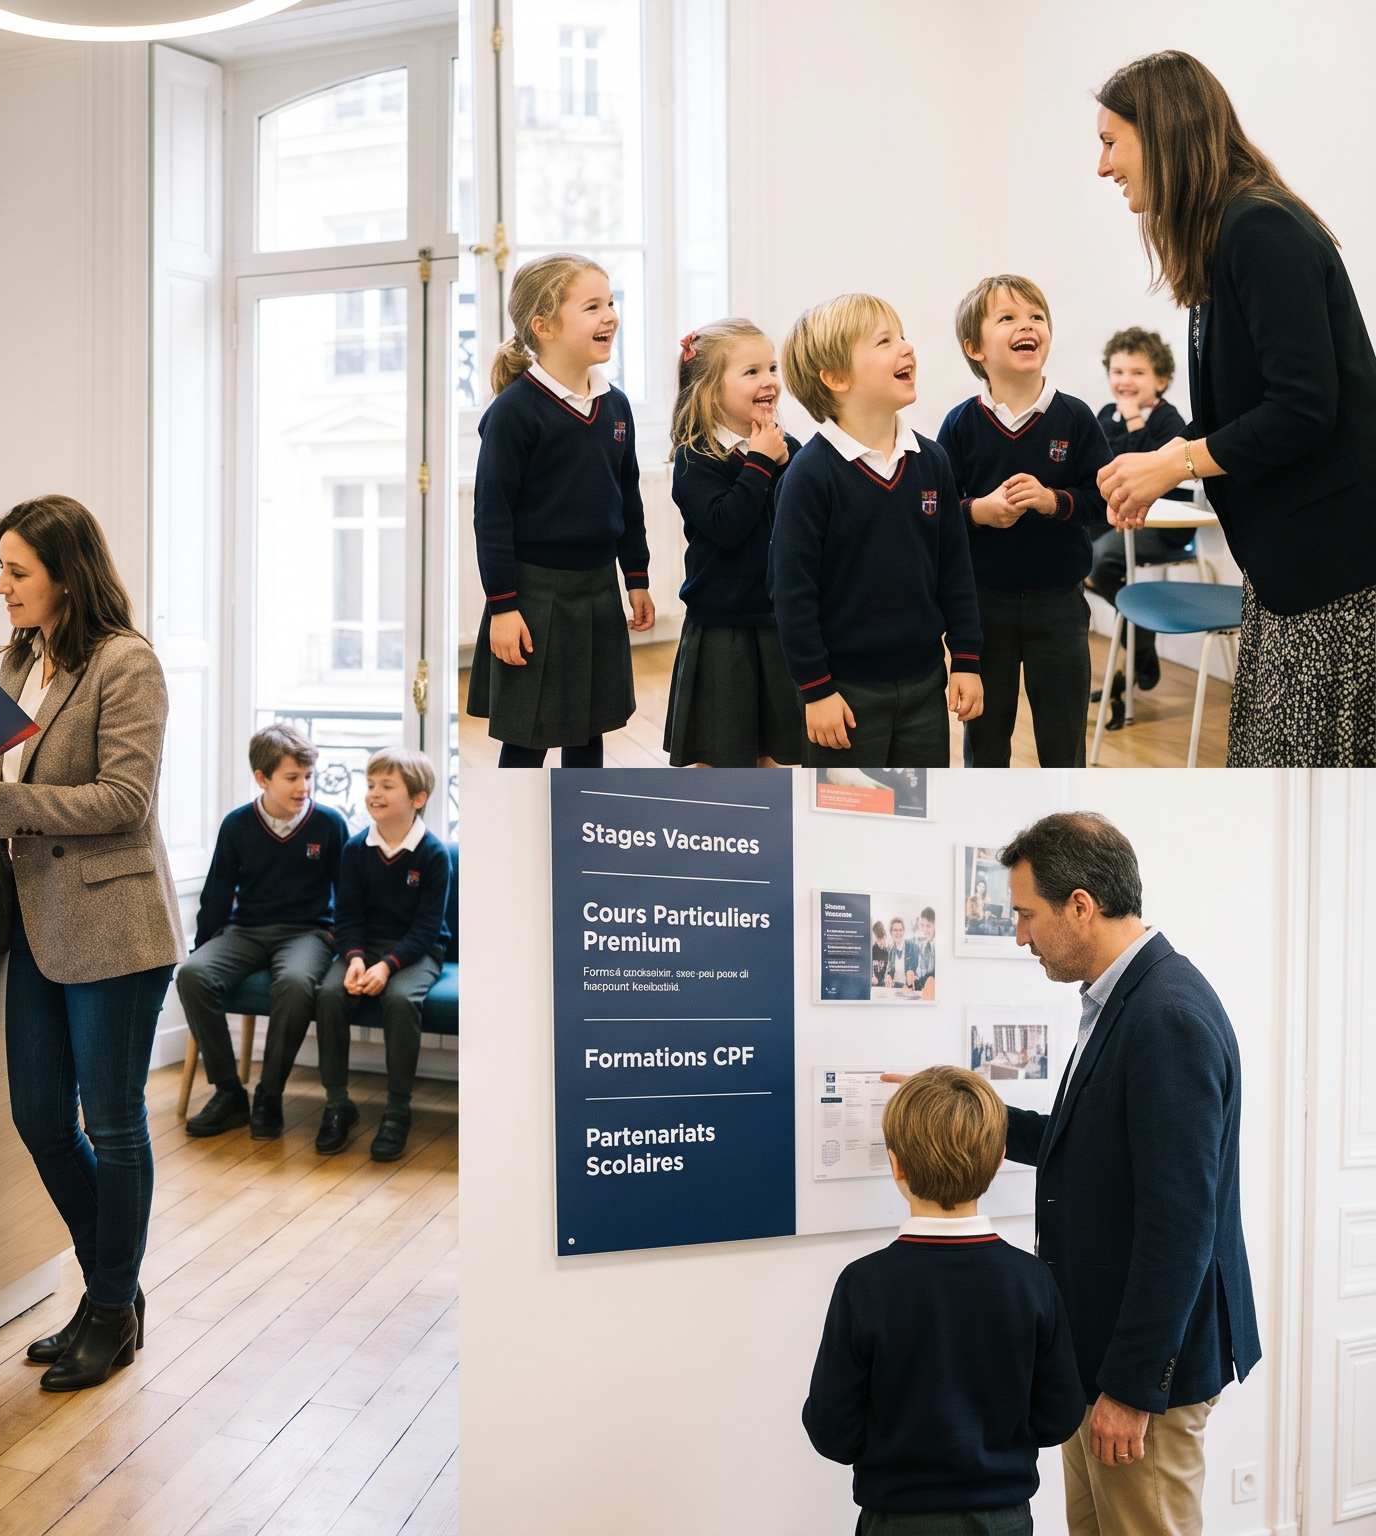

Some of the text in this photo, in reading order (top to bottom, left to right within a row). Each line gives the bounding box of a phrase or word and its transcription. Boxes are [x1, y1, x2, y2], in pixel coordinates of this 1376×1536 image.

[581, 821, 760, 855] Stages Vacances
[583, 901, 771, 929] Cours Particuliers
[583, 931, 681, 954] Premium
[585, 1046, 755, 1069] Formations CPF
[586, 1123, 716, 1148] Partenariats
[586, 1152, 684, 1177] Scolaires
